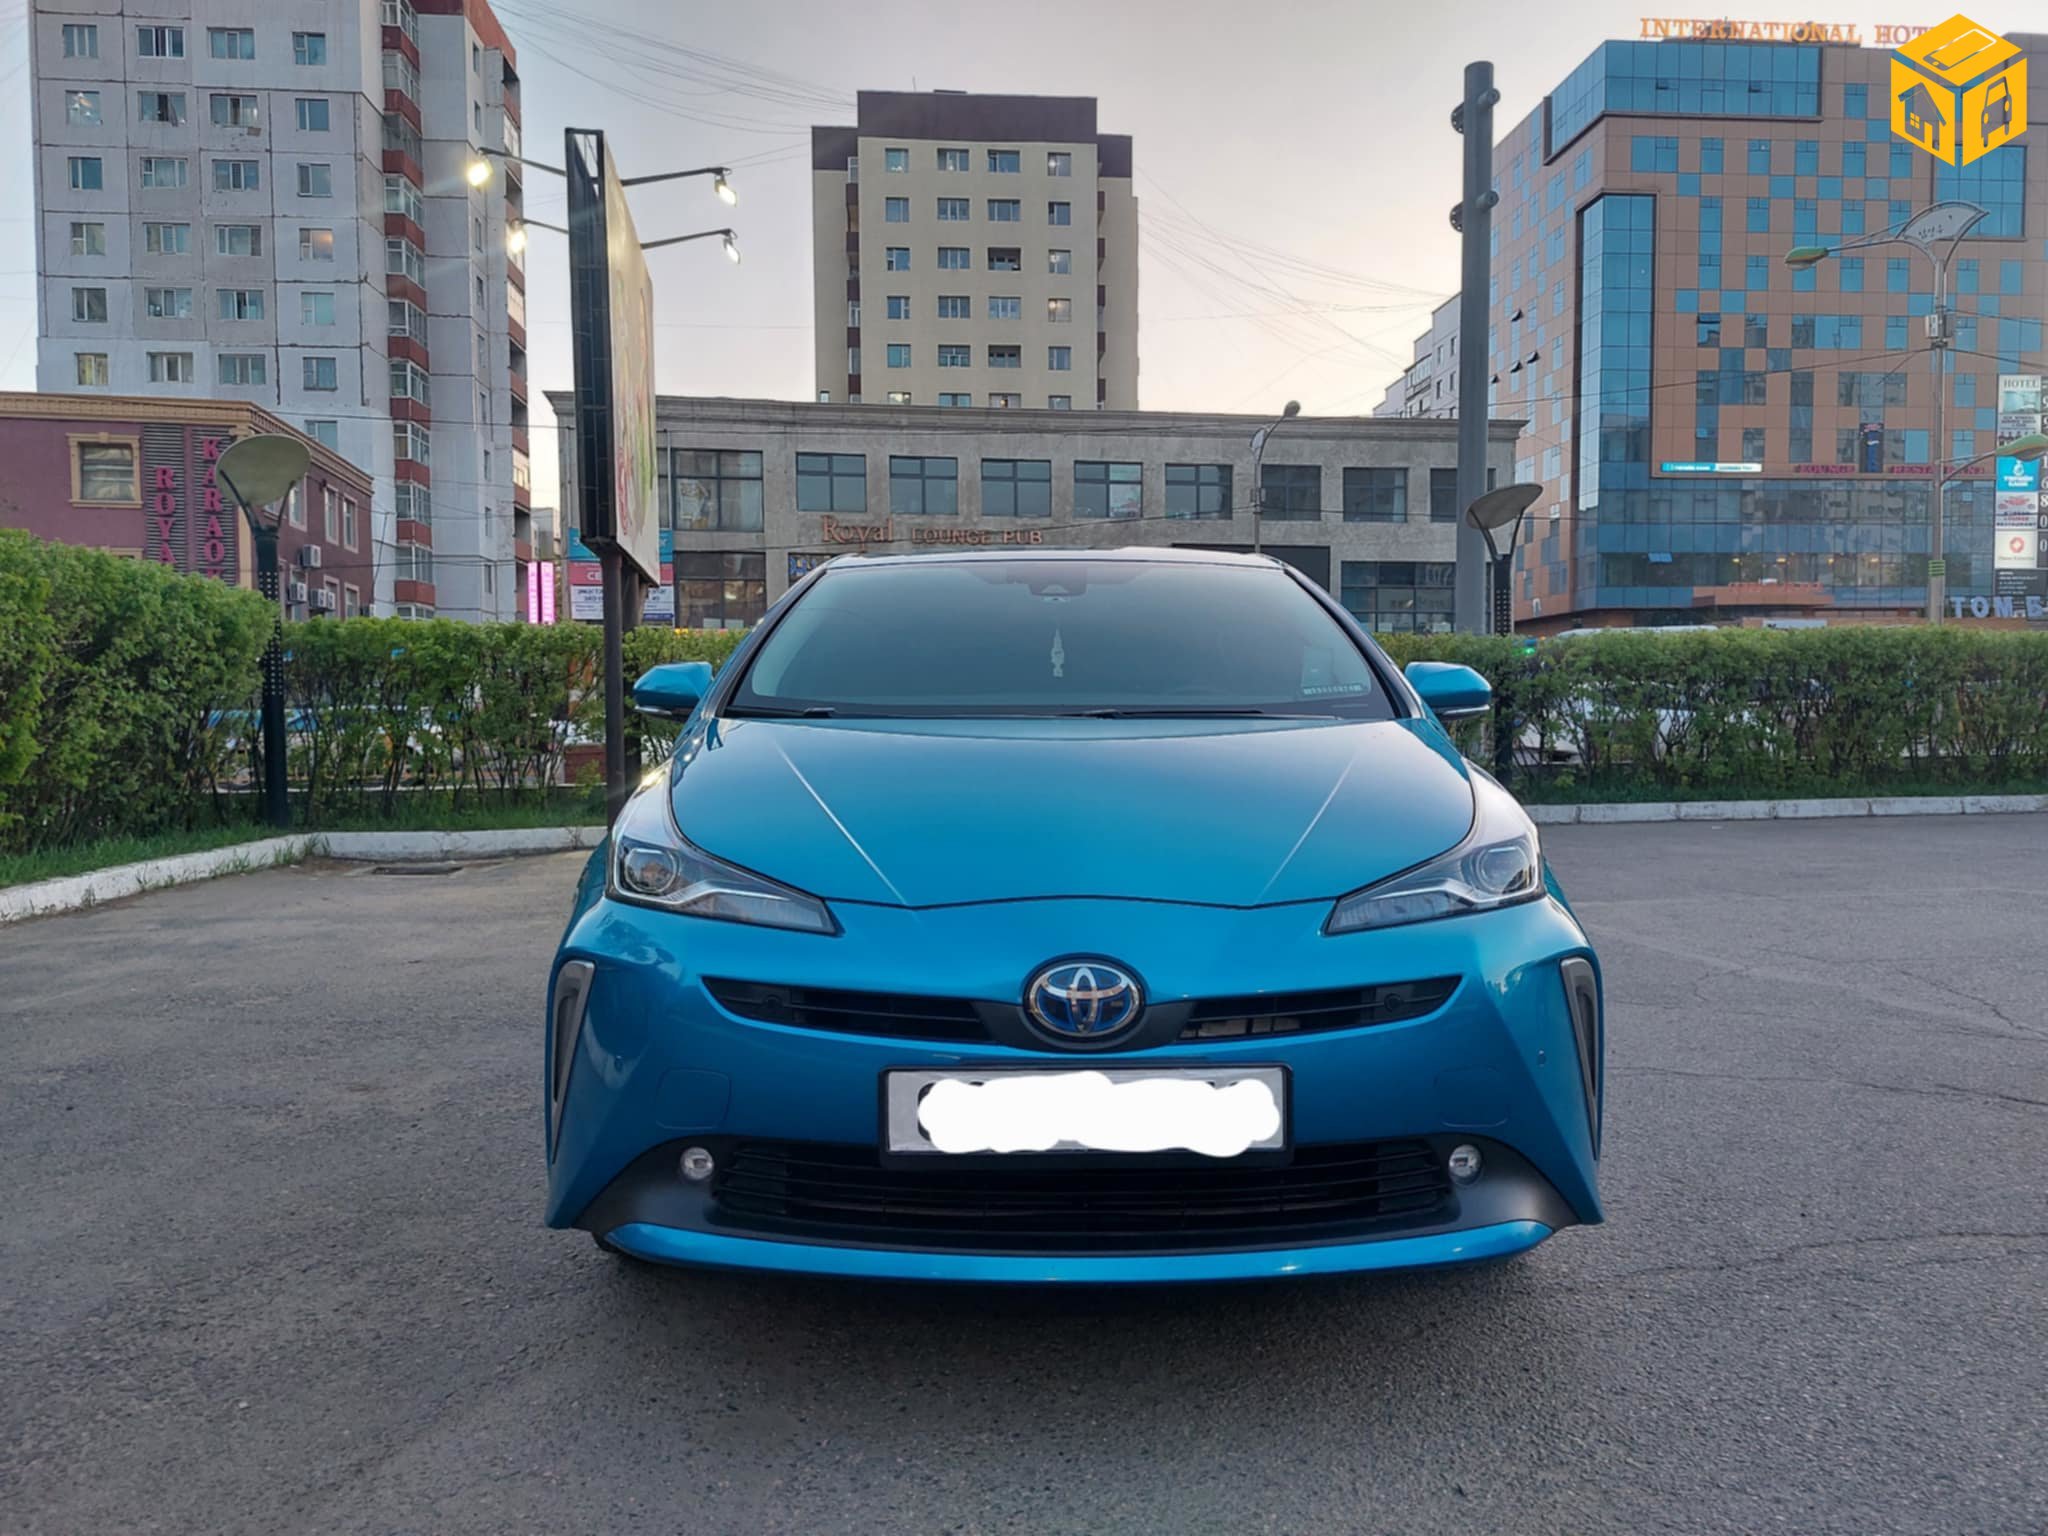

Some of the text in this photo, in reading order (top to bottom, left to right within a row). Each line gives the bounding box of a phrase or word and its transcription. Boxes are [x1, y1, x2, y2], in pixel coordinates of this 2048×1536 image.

[1640, 17, 1935, 44] INTERNATIONAL HOT
[2003, 378, 2039, 389] HOTEL
[154, 465, 177, 564] ROYA
[202, 436, 225, 577] KARAO
[821, 515, 1043, 553] Royal LOUNGE PUB
